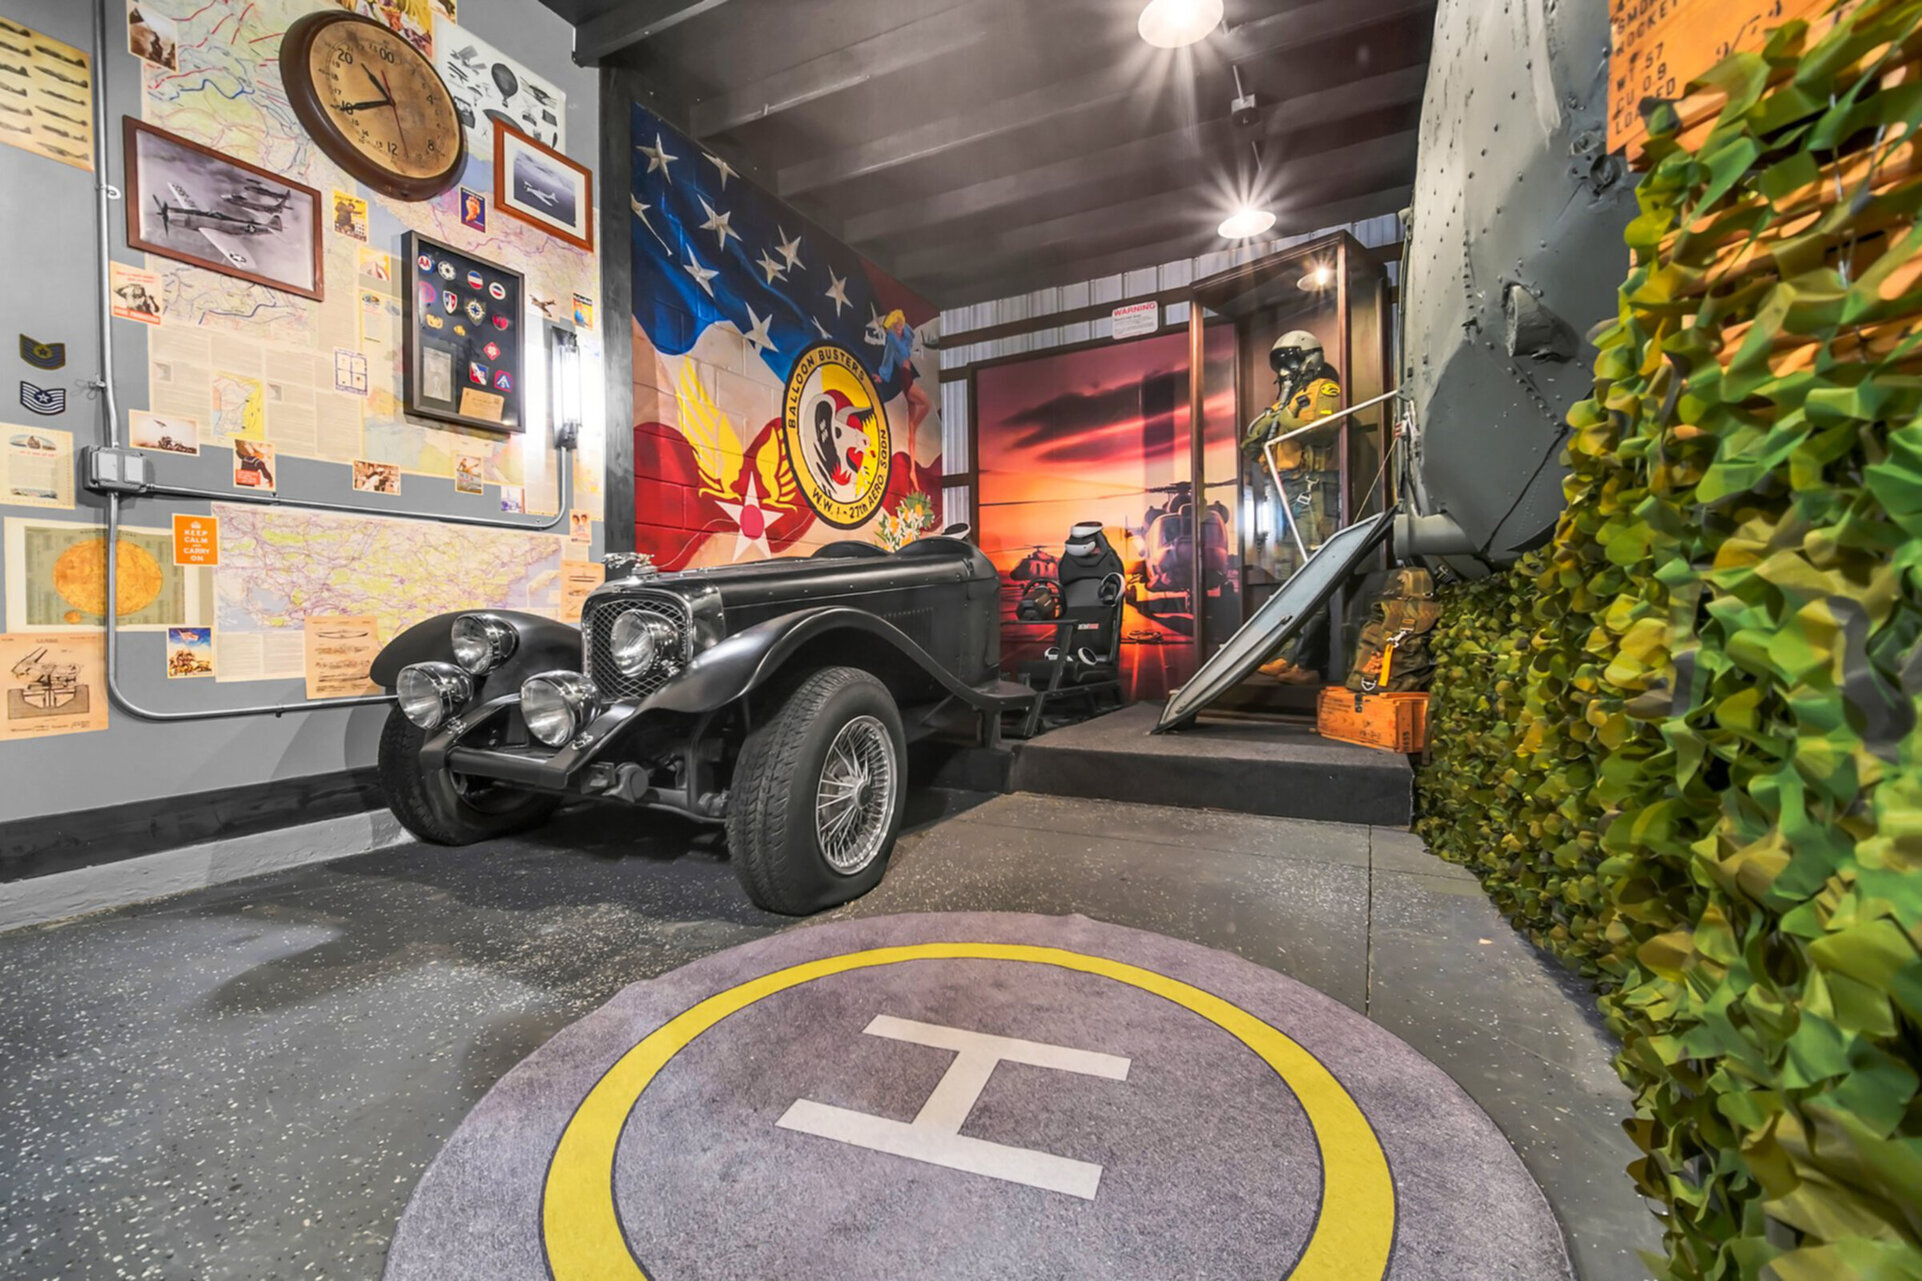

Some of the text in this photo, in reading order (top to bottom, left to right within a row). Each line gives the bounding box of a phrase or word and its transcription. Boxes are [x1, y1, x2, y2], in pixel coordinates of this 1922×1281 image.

[338, 47, 354, 65] 20
[380, 47, 395, 64] 00
[1616, 76, 1676, 135] LOED
[387, 141, 399, 157] 12
[1114, 302, 1156, 317] WARNING
[787, 349, 865, 429] BALLOON BUSTERS
[849, 503, 868, 519] 27th
[868, 474, 884, 506] AERO
[880, 429, 888, 469] SQDN
[184, 529, 208, 537] KEEP
[183, 547, 210, 555] CARRY
[774, 1014, 1132, 1200] H
